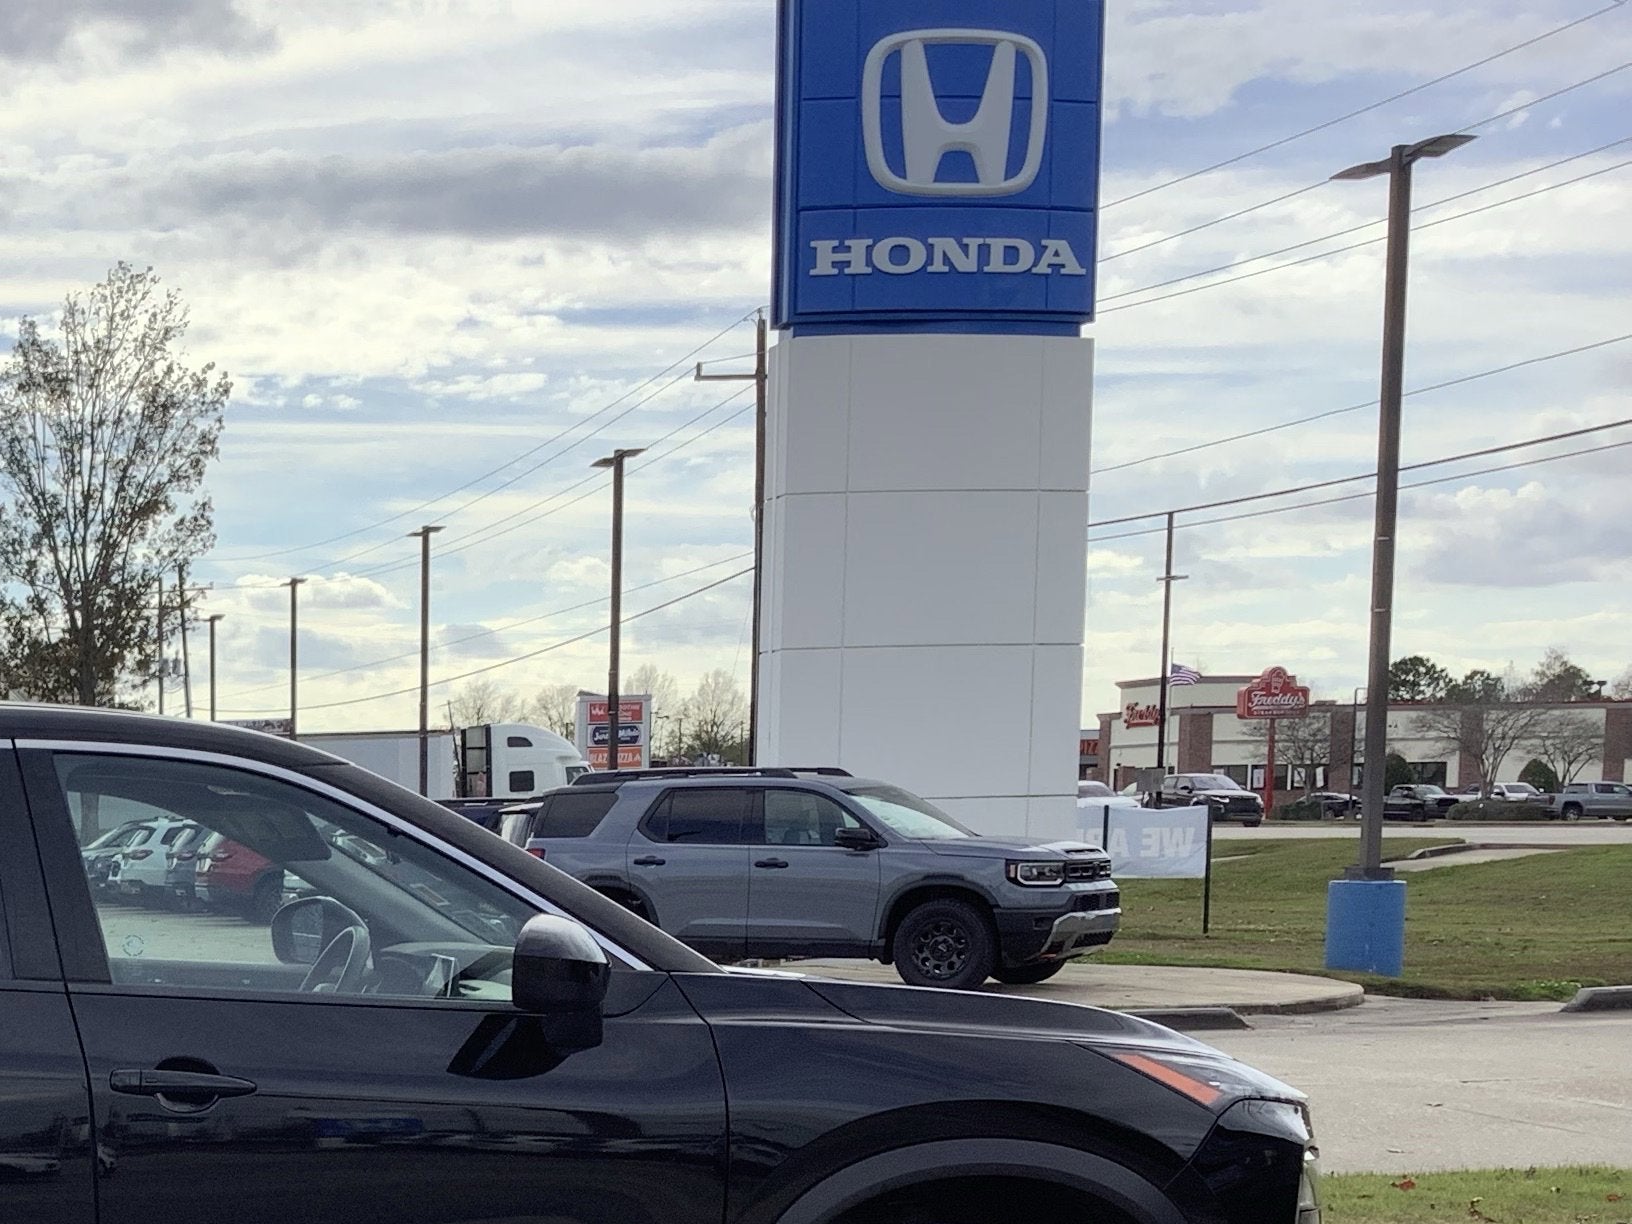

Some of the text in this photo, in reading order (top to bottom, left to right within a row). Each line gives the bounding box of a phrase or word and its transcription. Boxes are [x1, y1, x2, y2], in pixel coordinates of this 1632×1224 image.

[809, 237, 1087, 276] HONDA
[1248, 690, 1306, 710] Freddy's
[589, 752, 633, 764] BLAZ IZZA
